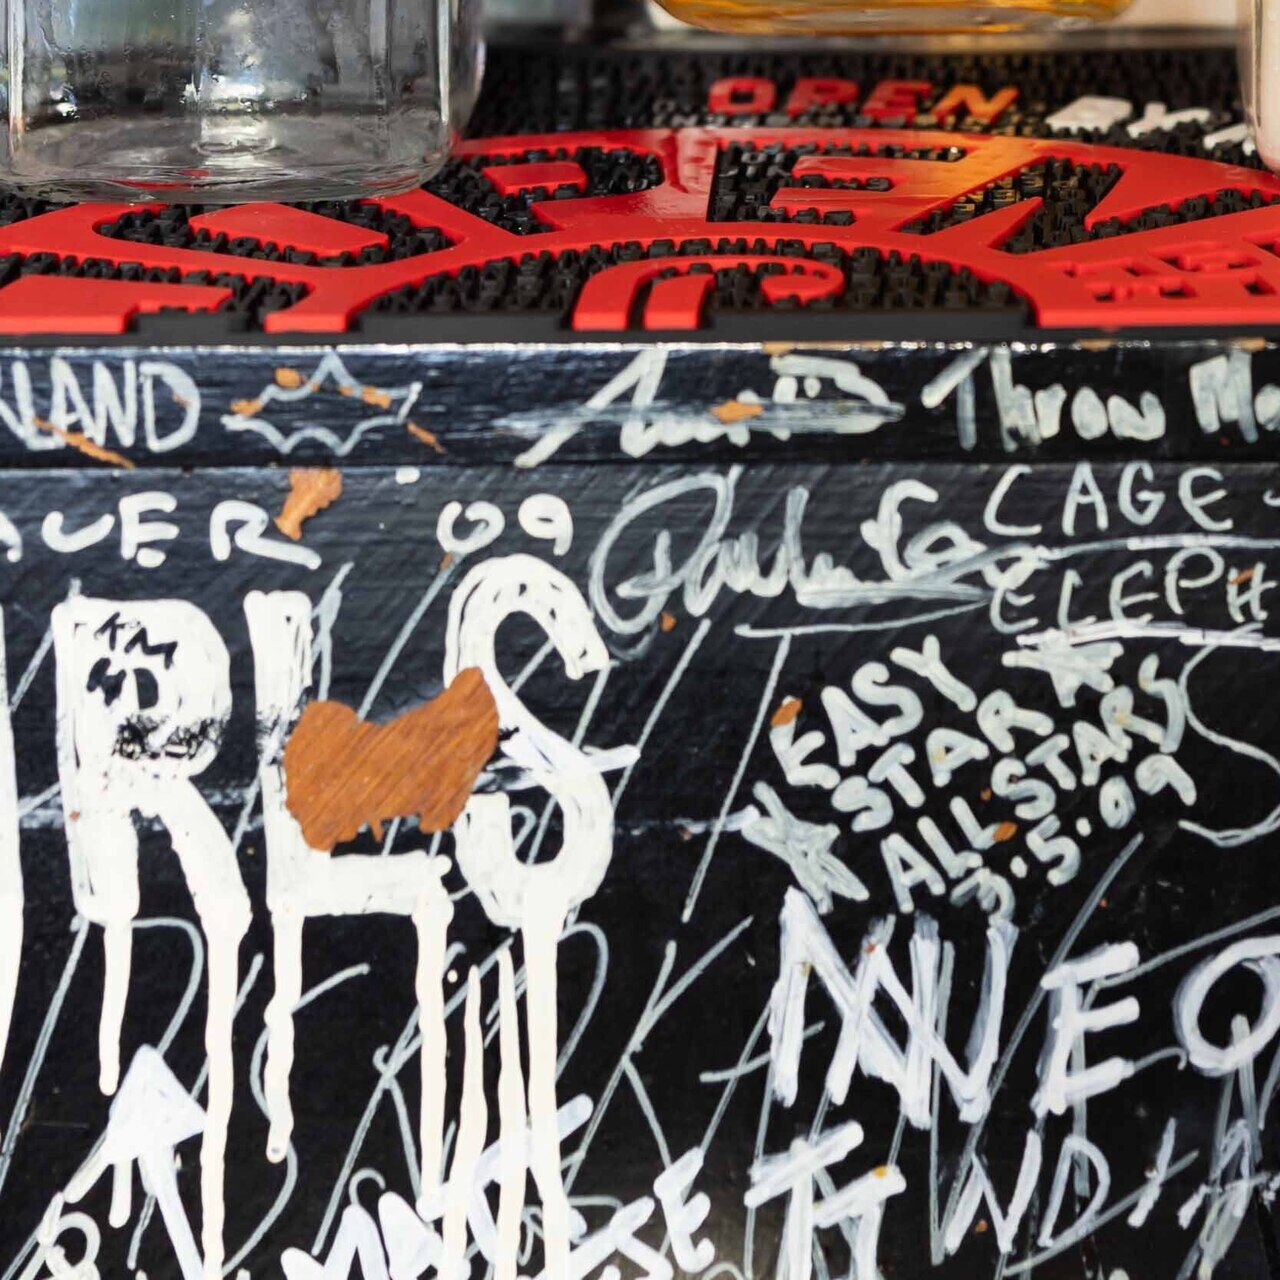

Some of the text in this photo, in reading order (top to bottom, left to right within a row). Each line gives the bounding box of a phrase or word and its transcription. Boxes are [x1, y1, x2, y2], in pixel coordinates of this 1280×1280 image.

[707, 74, 1020, 130] OPEN
[982, 462, 1235, 537] CAGE
[770, 635, 976, 790] EASY
[831, 688, 1055, 833] STAR
[880, 653, 1187, 914] ALL STARS
